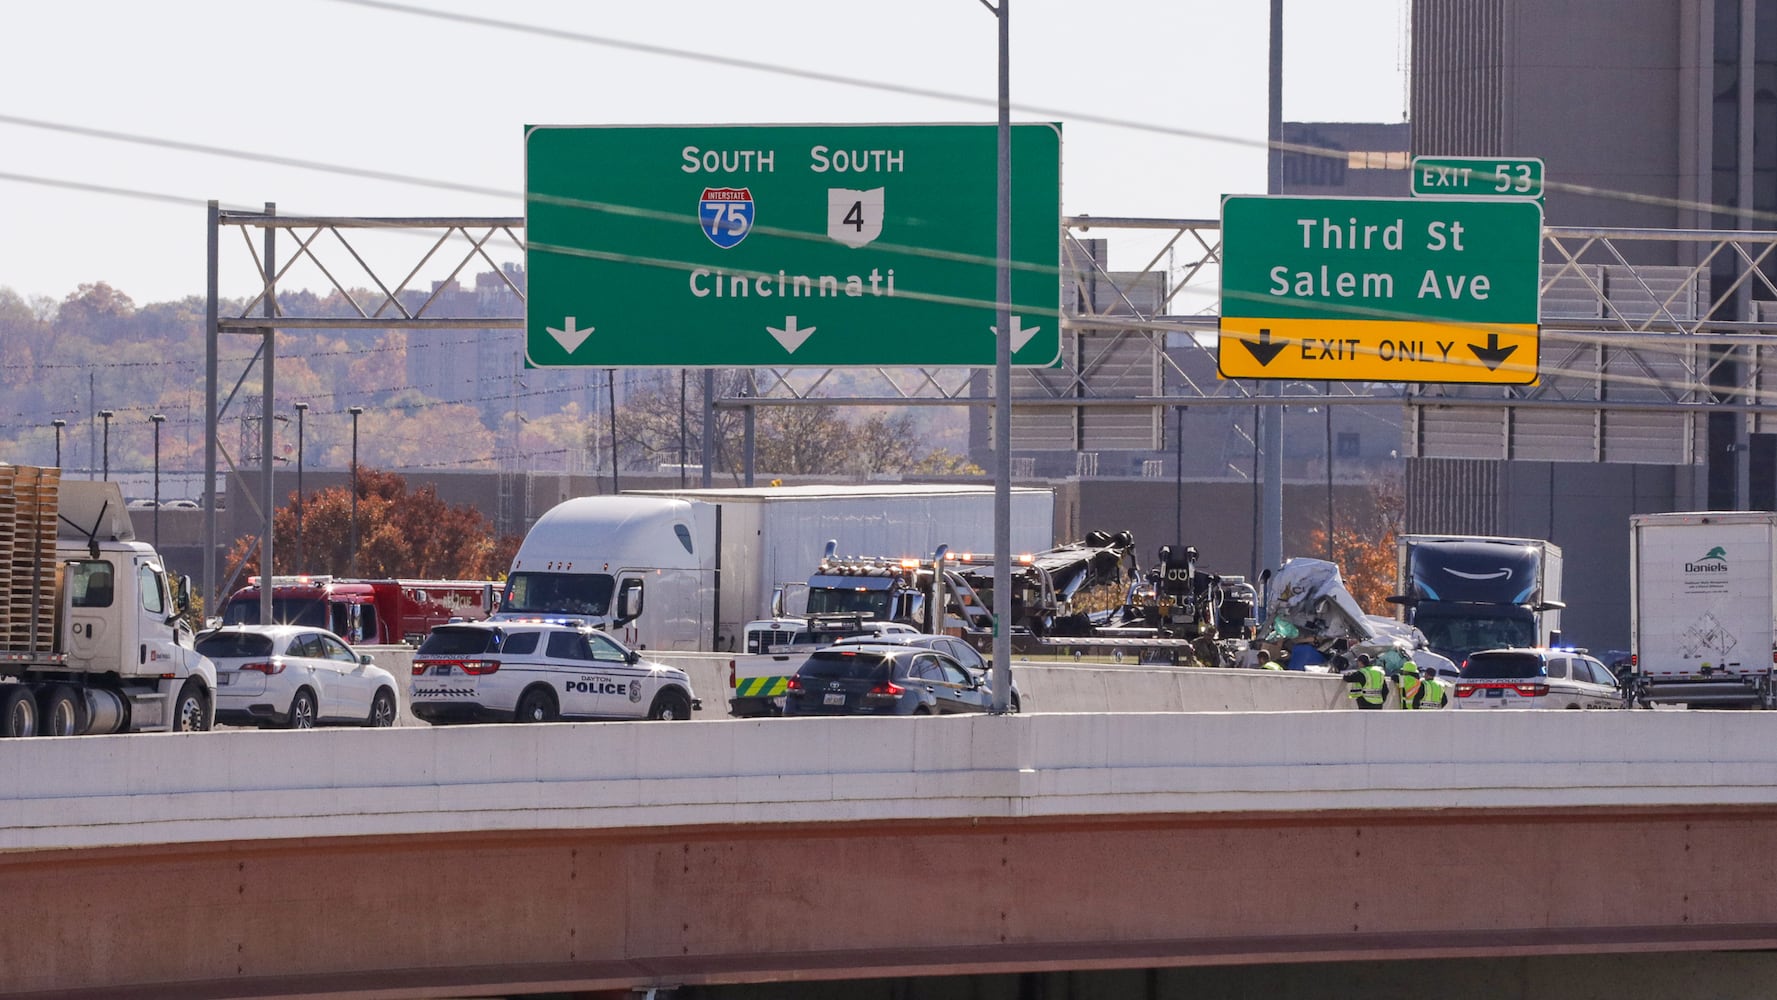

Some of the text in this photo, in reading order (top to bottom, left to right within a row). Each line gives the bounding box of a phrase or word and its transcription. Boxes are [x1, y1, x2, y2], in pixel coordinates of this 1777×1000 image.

[682, 146, 904, 172] SOUTH SOUTH
[1423, 165, 1533, 192] EXIT 53
[707, 192, 745, 200] INTERSTATE
[706, 203, 748, 236] 75
[843, 201, 863, 232] 4
[1298, 218, 1464, 250] Third St
[690, 268, 895, 297] Cincinnati
[1270, 265, 1490, 299] Salem Ave
[1302, 339, 1455, 363] EXIT ONLY
[1685, 562, 1728, 573] Daniels
[566, 681, 627, 695] POLICE
